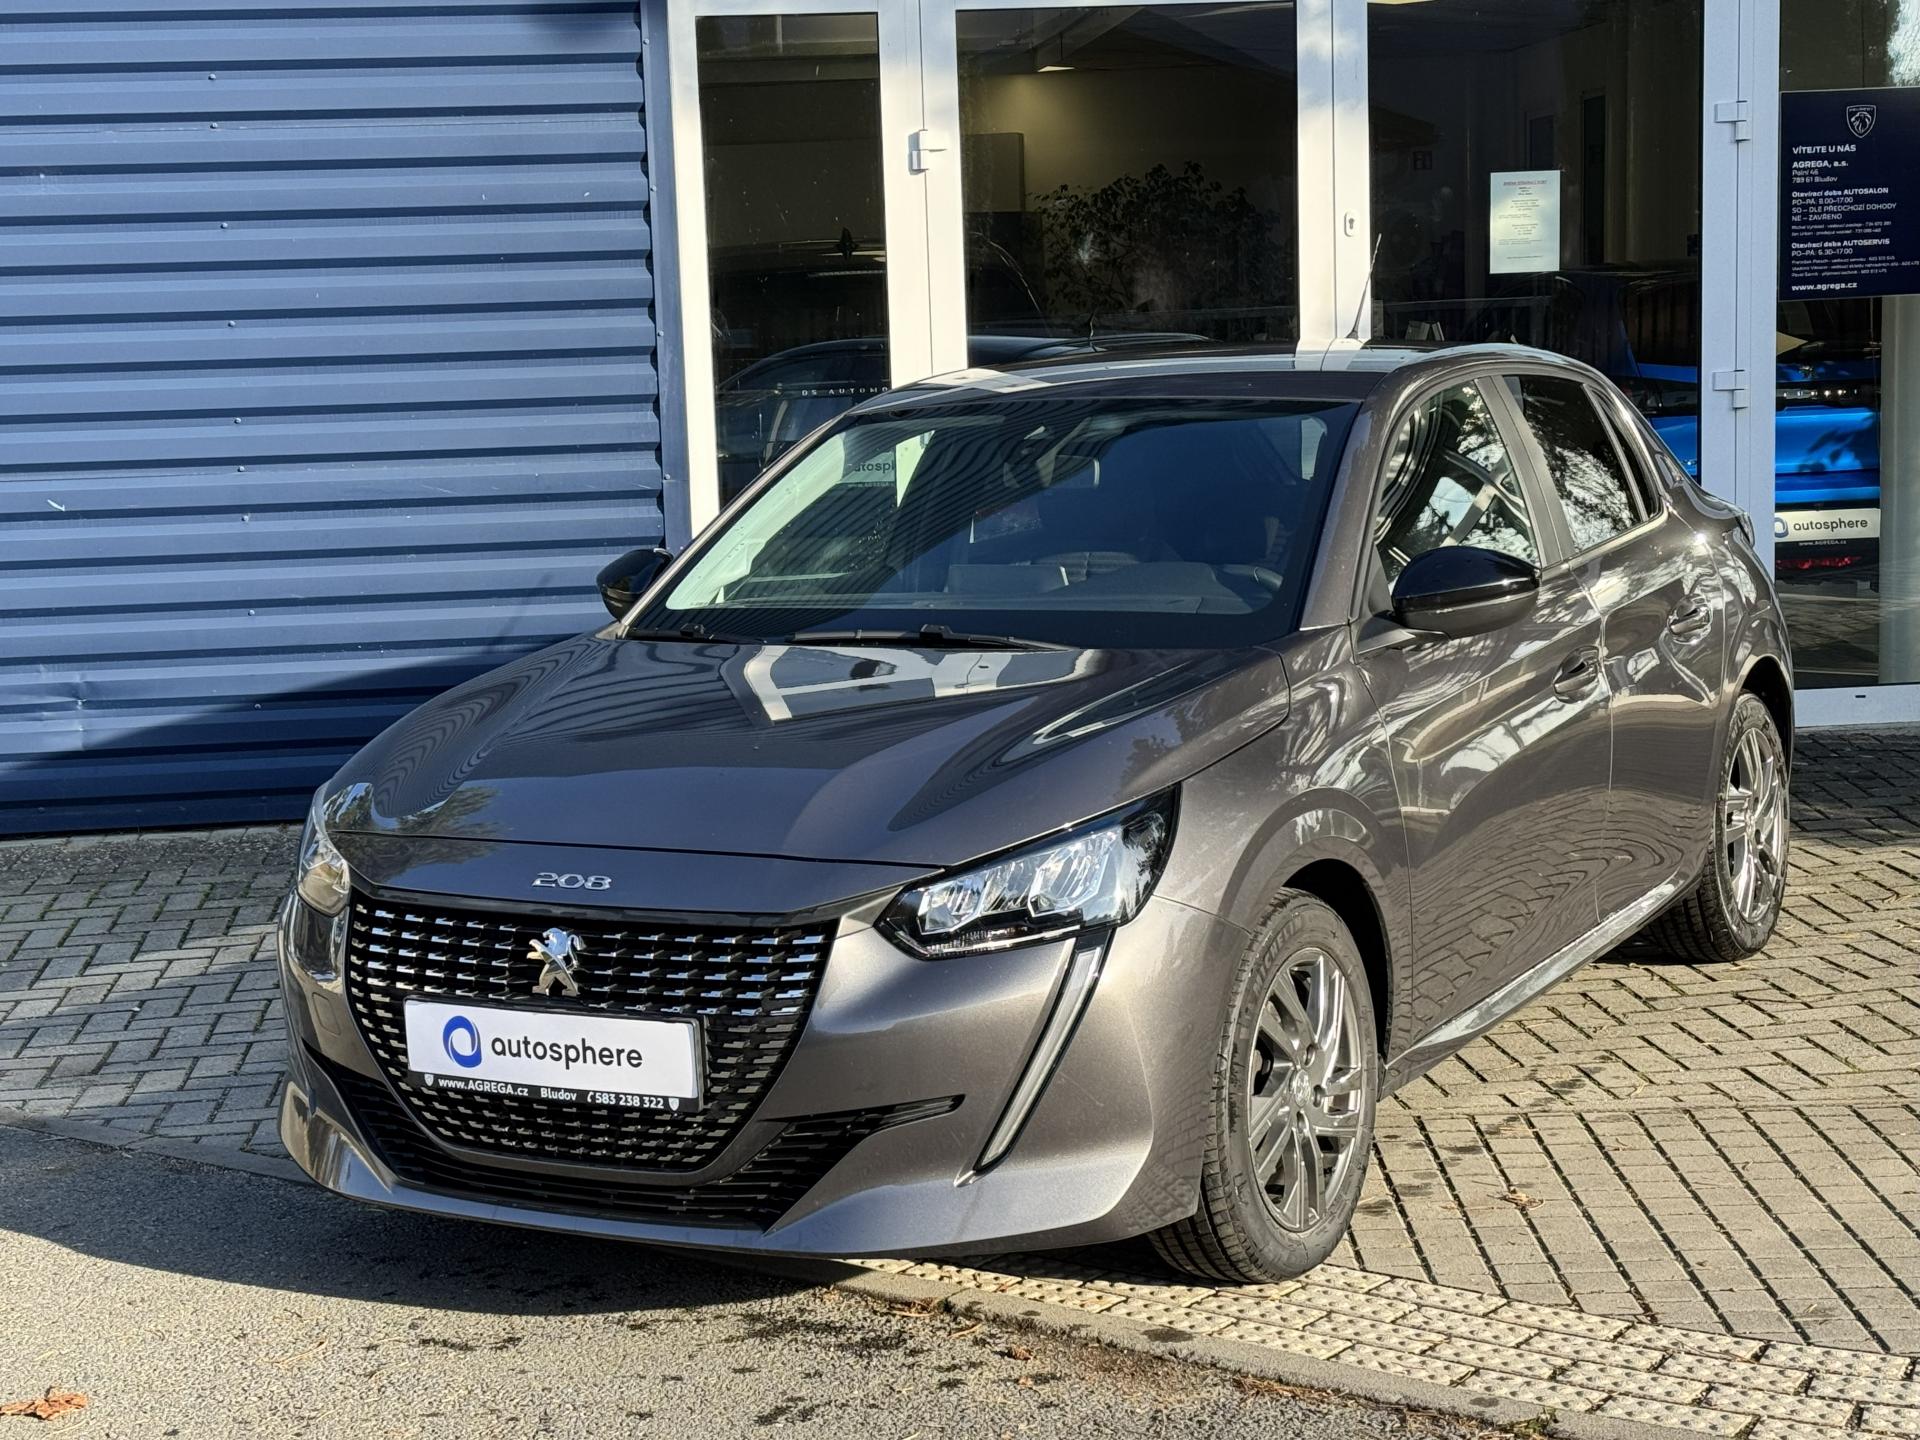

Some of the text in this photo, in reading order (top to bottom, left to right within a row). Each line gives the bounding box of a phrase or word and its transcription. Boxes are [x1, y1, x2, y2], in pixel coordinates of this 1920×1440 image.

[1792, 143, 1857, 154] VÍTEJTE U NÁS
[1792, 160, 1832, 169] AGREGA,
[1843, 187, 1889, 195] AUTOSALON
[1866, 202, 1897, 210] DOHODY
[1842, 238, 1890, 247] AUTOSERVIS
[1792, 282, 1858, 291] www.agrega.cz
[1793, 518, 1868, 532] autosphere
[532, 872, 612, 891] 208
[491, 1036, 643, 1070] autosphere
[438, 1077, 665, 1109] www.AGREGA.cz Bludov 583 238 322
